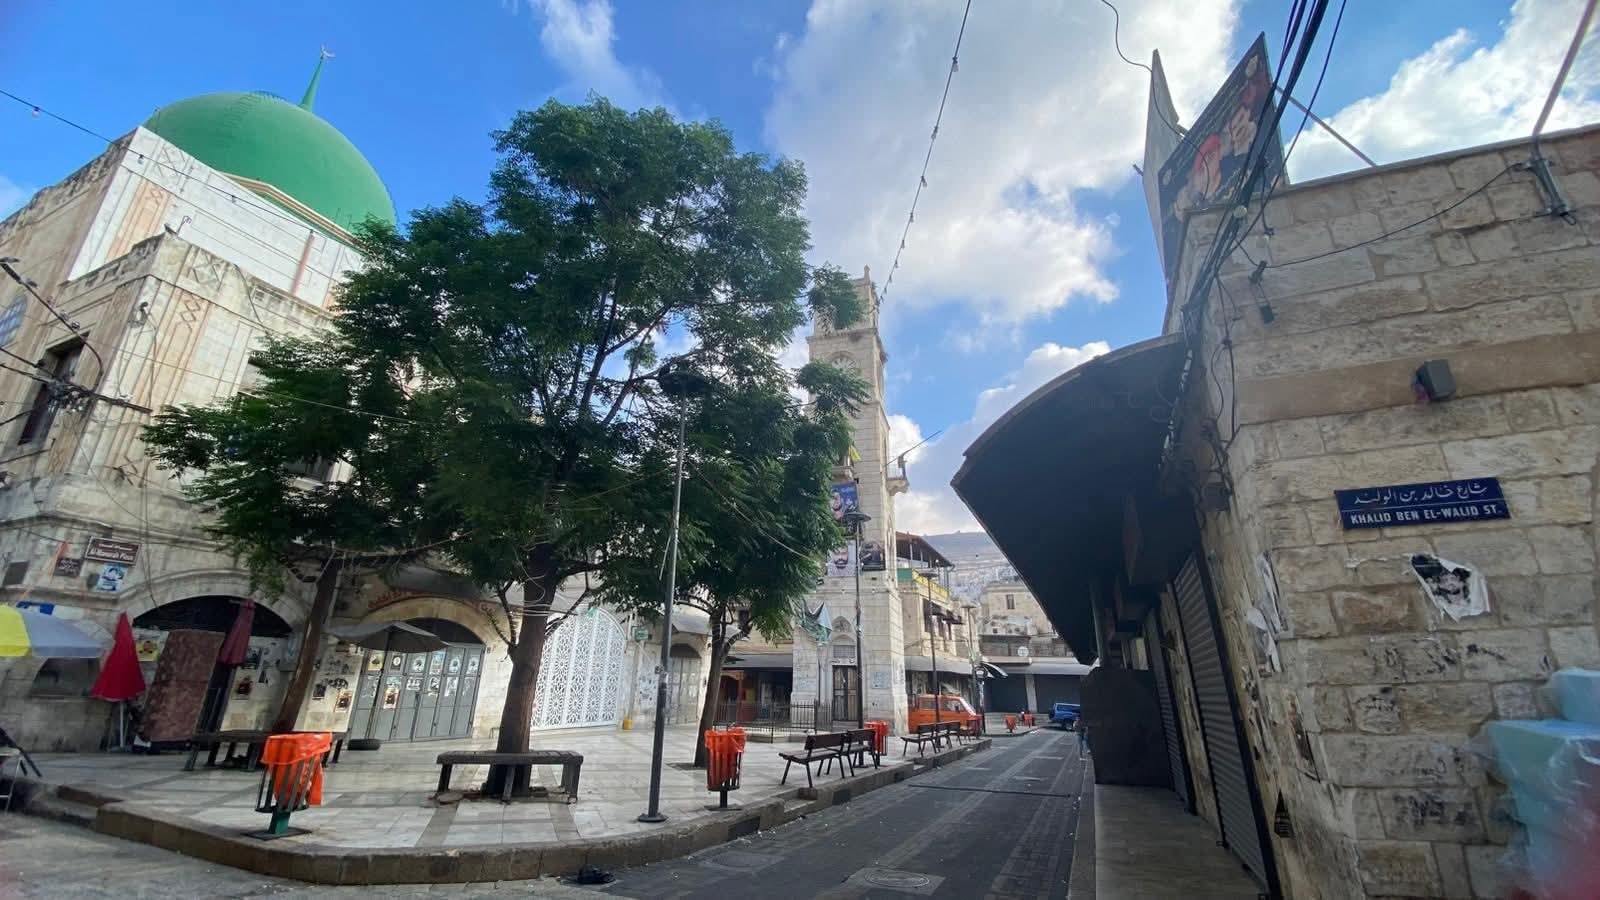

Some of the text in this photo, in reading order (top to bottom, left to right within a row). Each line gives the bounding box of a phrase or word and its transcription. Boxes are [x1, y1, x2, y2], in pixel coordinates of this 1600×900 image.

[1354, 481, 1488, 505] شارع خالد بن الوليد
[1350, 512, 1392, 525] KHALID
[1396, 510, 1420, 521] BEN
[1424, 505, 1479, 519] EL-WALID
